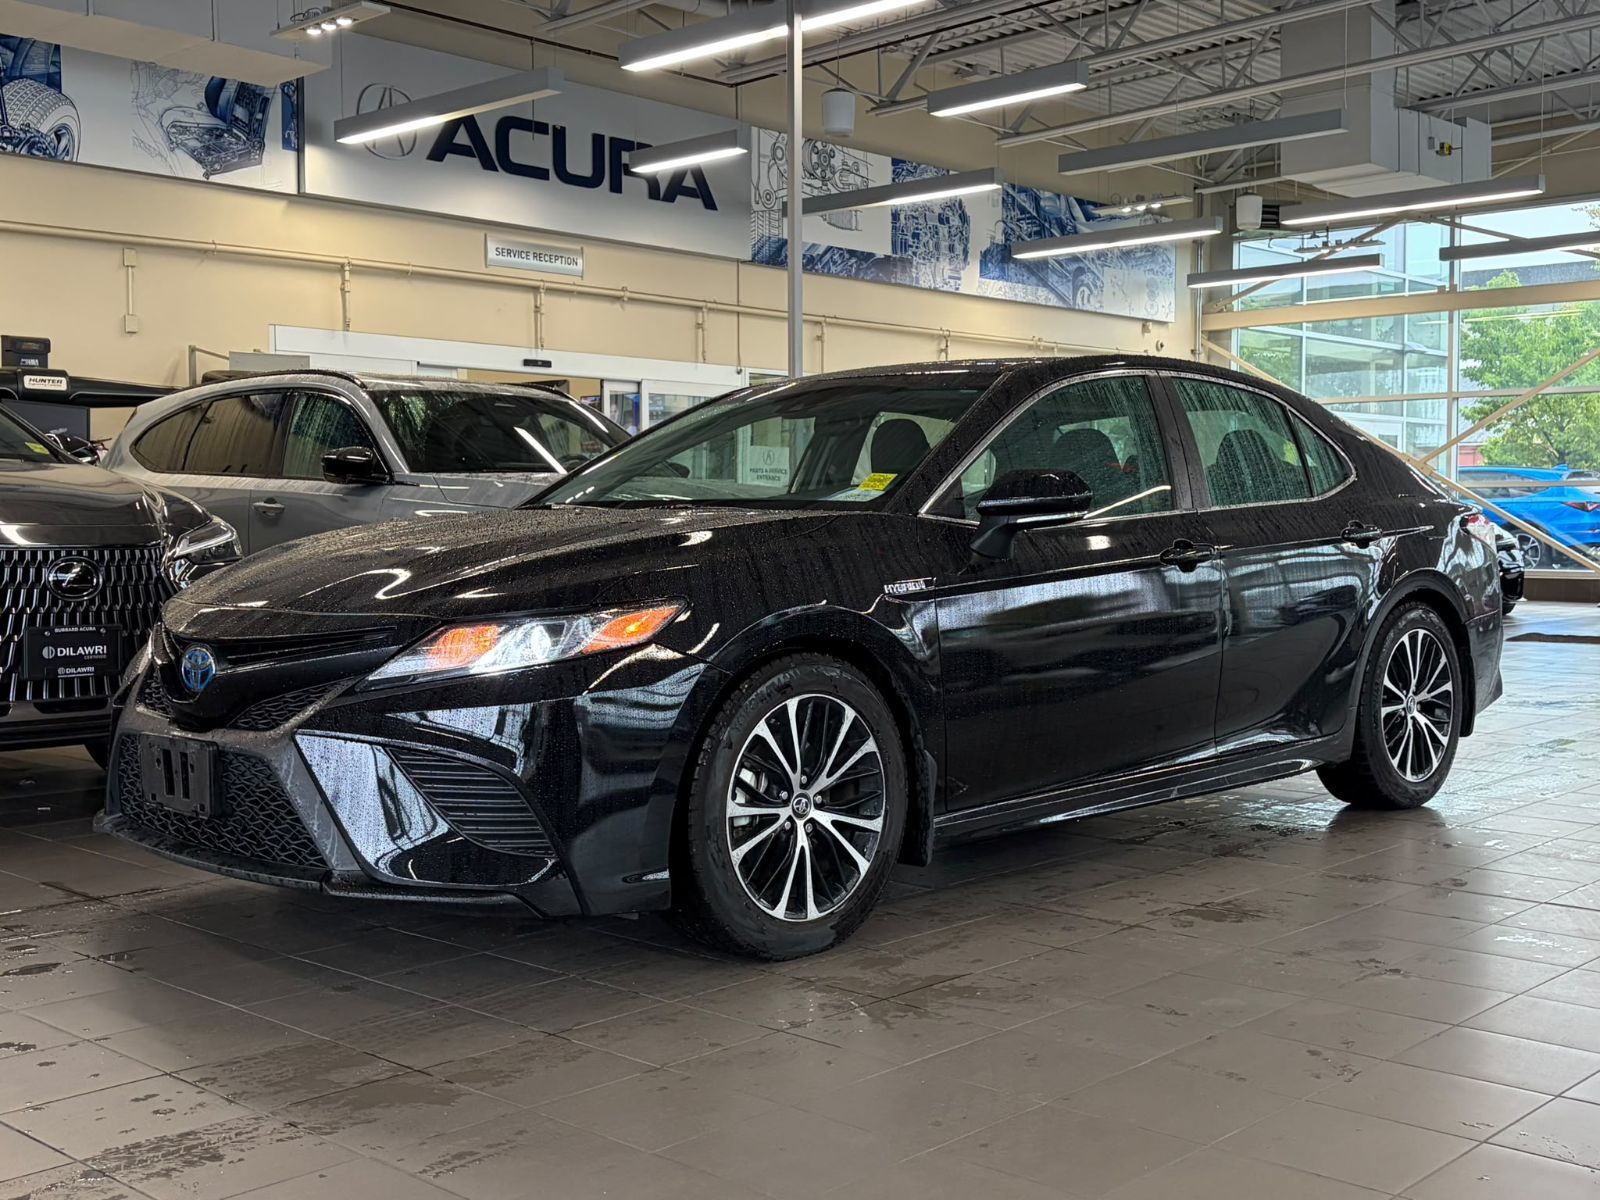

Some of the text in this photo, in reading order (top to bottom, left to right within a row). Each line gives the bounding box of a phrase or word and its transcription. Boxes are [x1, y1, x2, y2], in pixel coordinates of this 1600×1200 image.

[425, 114, 718, 211] ACURA
[495, 247, 579, 266] SERVICE RECEPTION
[57, 645, 107, 657] DILAWRI
[65, 666, 95, 674] DILAWRI
